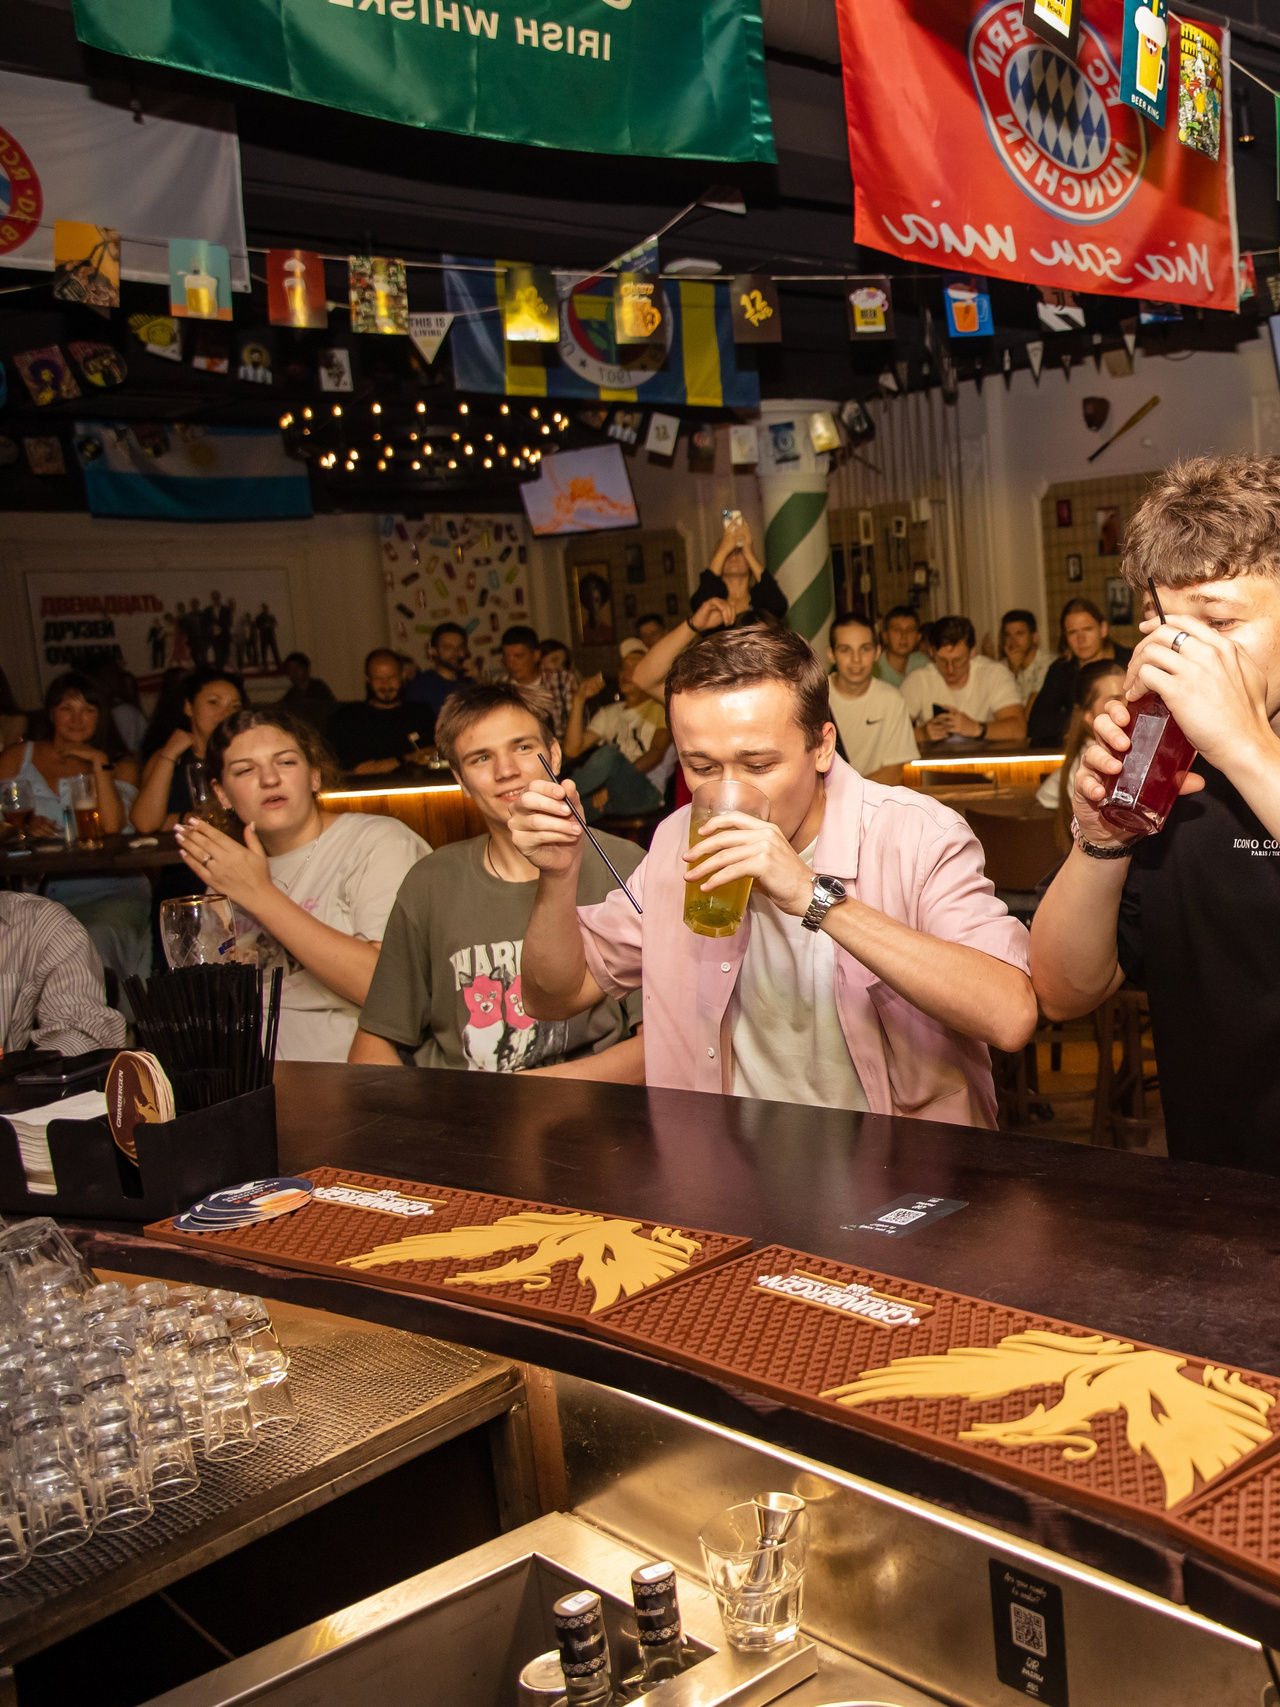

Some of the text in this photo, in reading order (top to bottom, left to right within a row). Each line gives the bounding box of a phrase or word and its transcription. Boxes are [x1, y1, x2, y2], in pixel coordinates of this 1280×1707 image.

[1131, 93, 1160, 121] BEER KING
[740, 288, 768, 320] 12
[409, 316, 446, 328] THIS IS
[413, 328, 442, 338] LIVING
[1232, 838, 1260, 850] ICONO
[116, 1069, 124, 1128] GRIMBERGEN
[757, 1275, 914, 1325] GRIMBERGEN
[1026, 1657, 1039, 1671] QR
